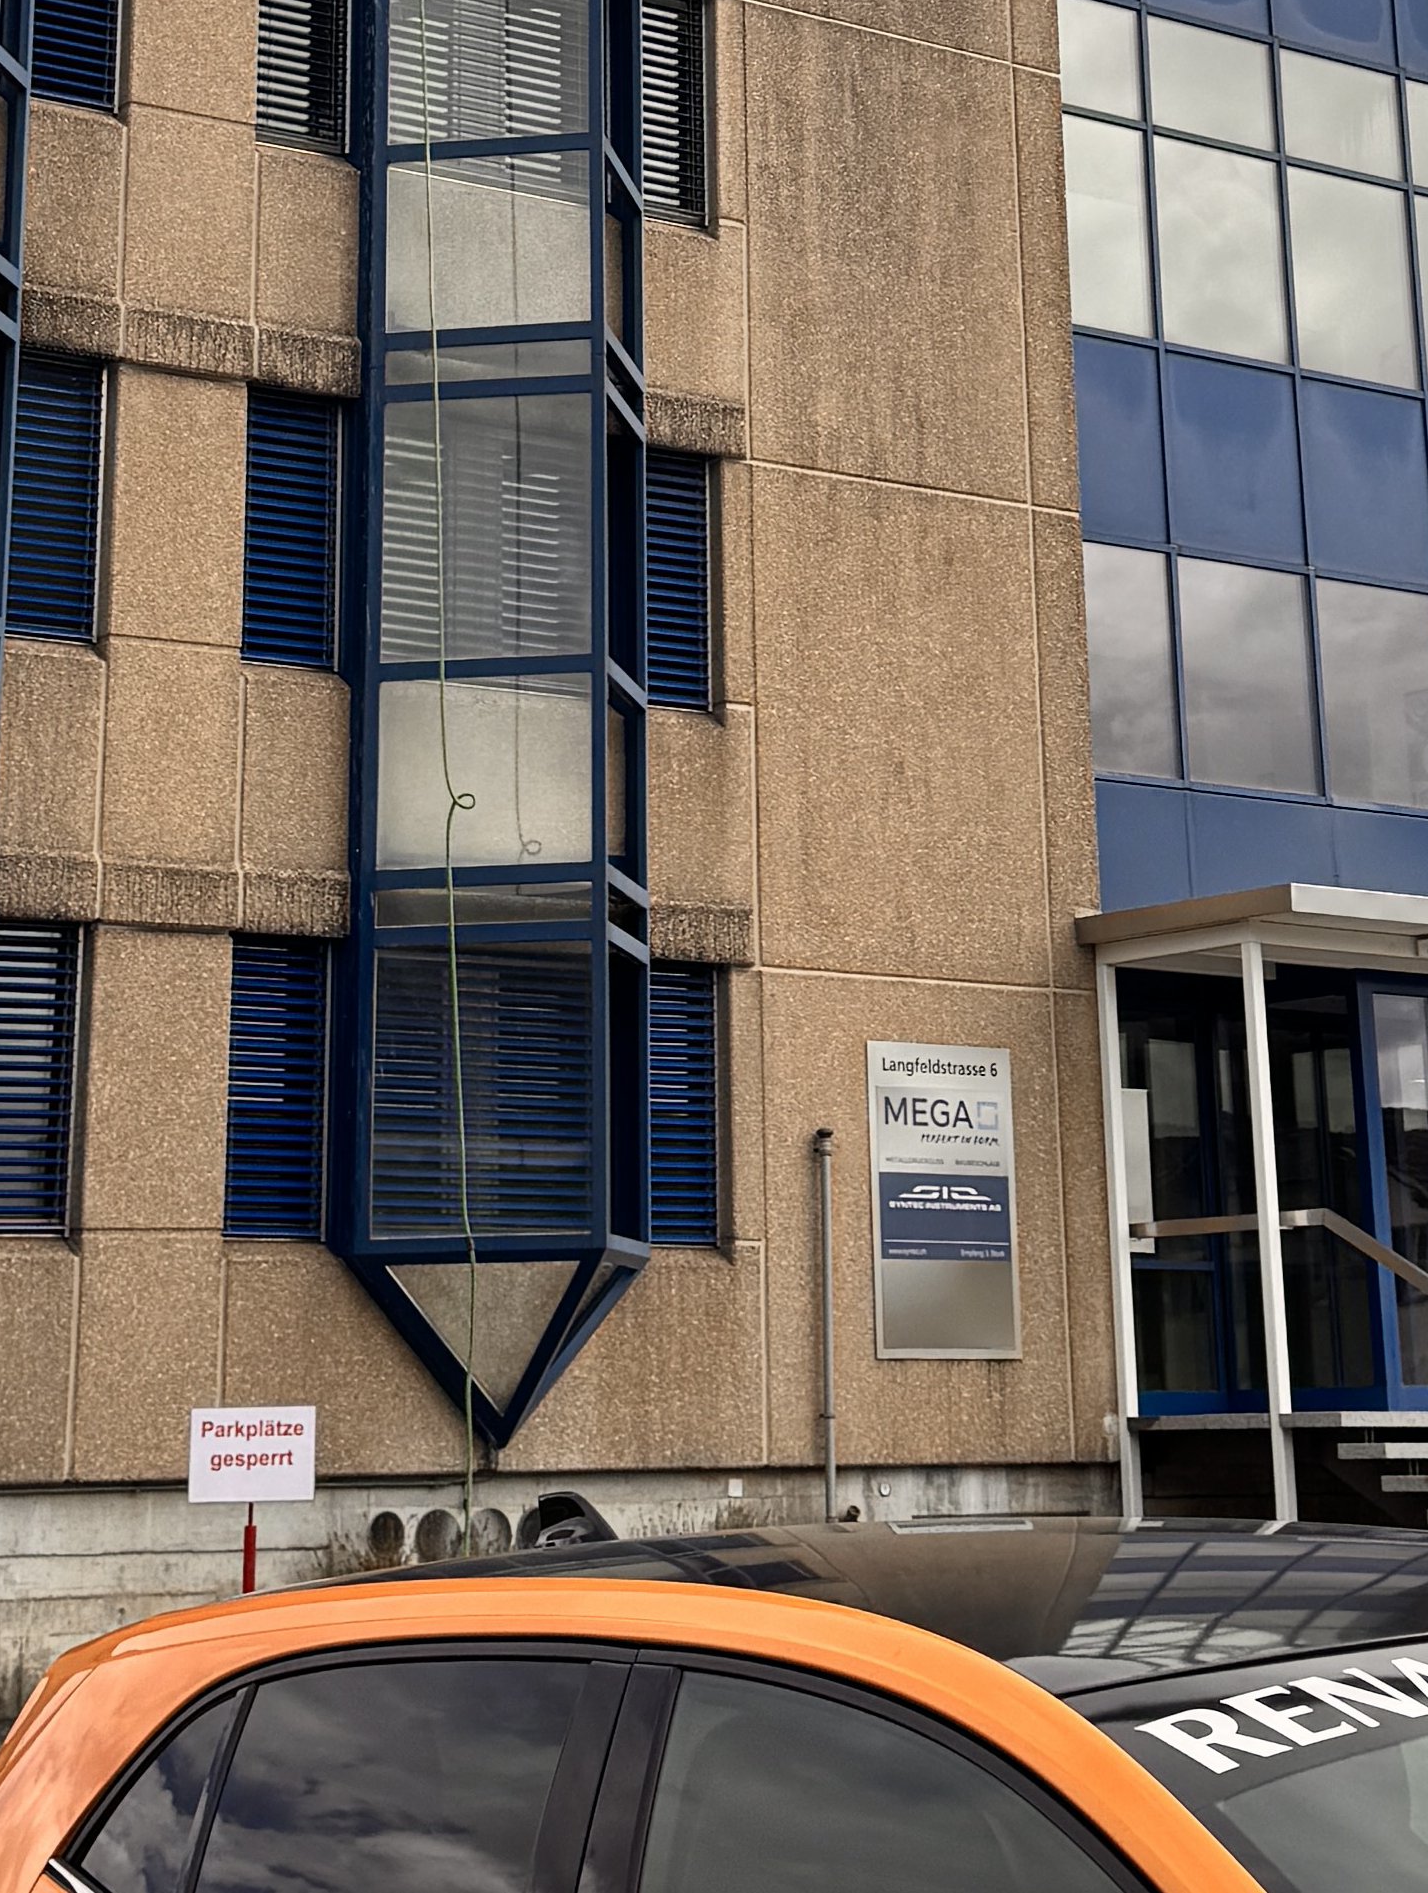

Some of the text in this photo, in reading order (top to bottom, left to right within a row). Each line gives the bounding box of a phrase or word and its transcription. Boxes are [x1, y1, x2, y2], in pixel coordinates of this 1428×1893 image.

[882, 1057, 998, 1077] Langfeldstrasse 6
[884, 1096, 974, 1129] MEGA
[201, 1420, 305, 1441] Parkplätze
[210, 1450, 294, 1472] gesperrt
